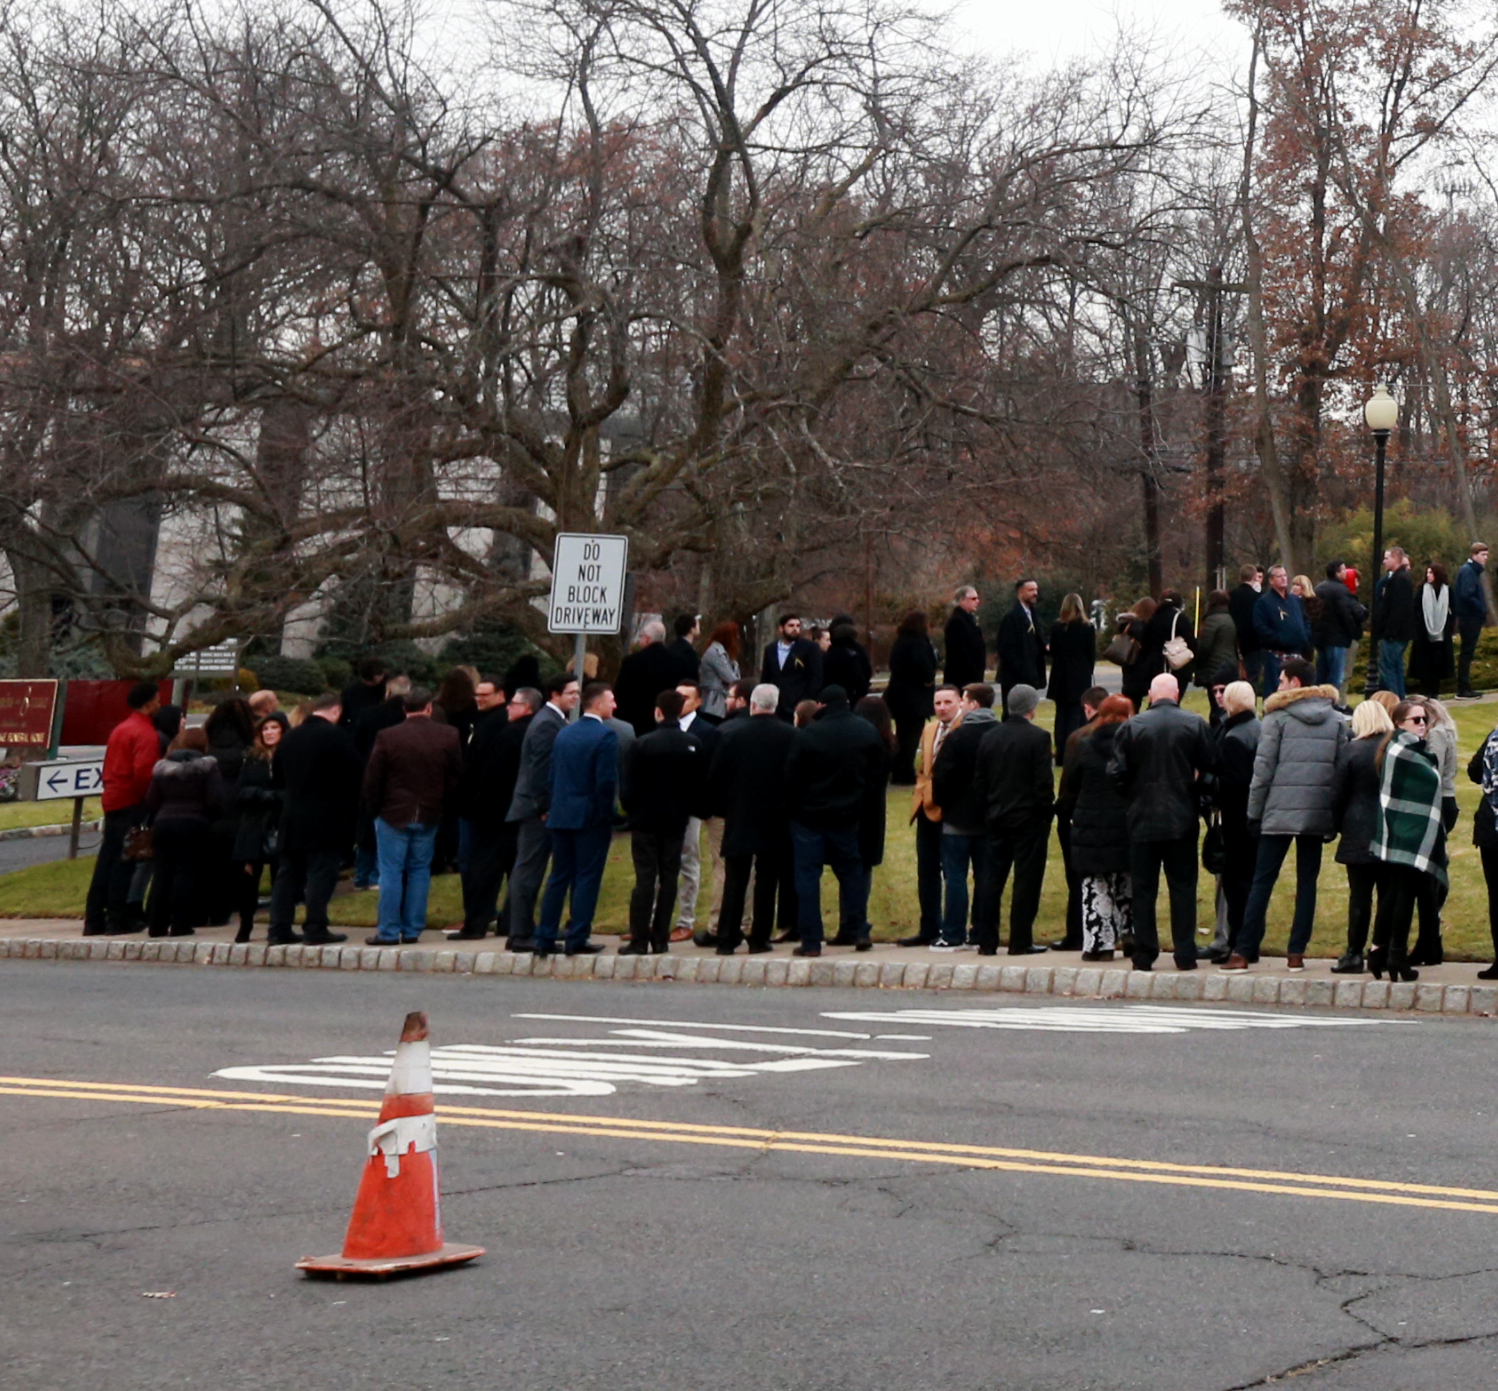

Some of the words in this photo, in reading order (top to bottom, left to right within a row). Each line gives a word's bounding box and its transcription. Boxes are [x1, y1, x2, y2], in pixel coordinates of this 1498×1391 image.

[583, 543, 600, 561] DO
[578, 564, 602, 582] NOT
[567, 585, 607, 603] BLOCK
[554, 606, 616, 625] DRIVEWAY
